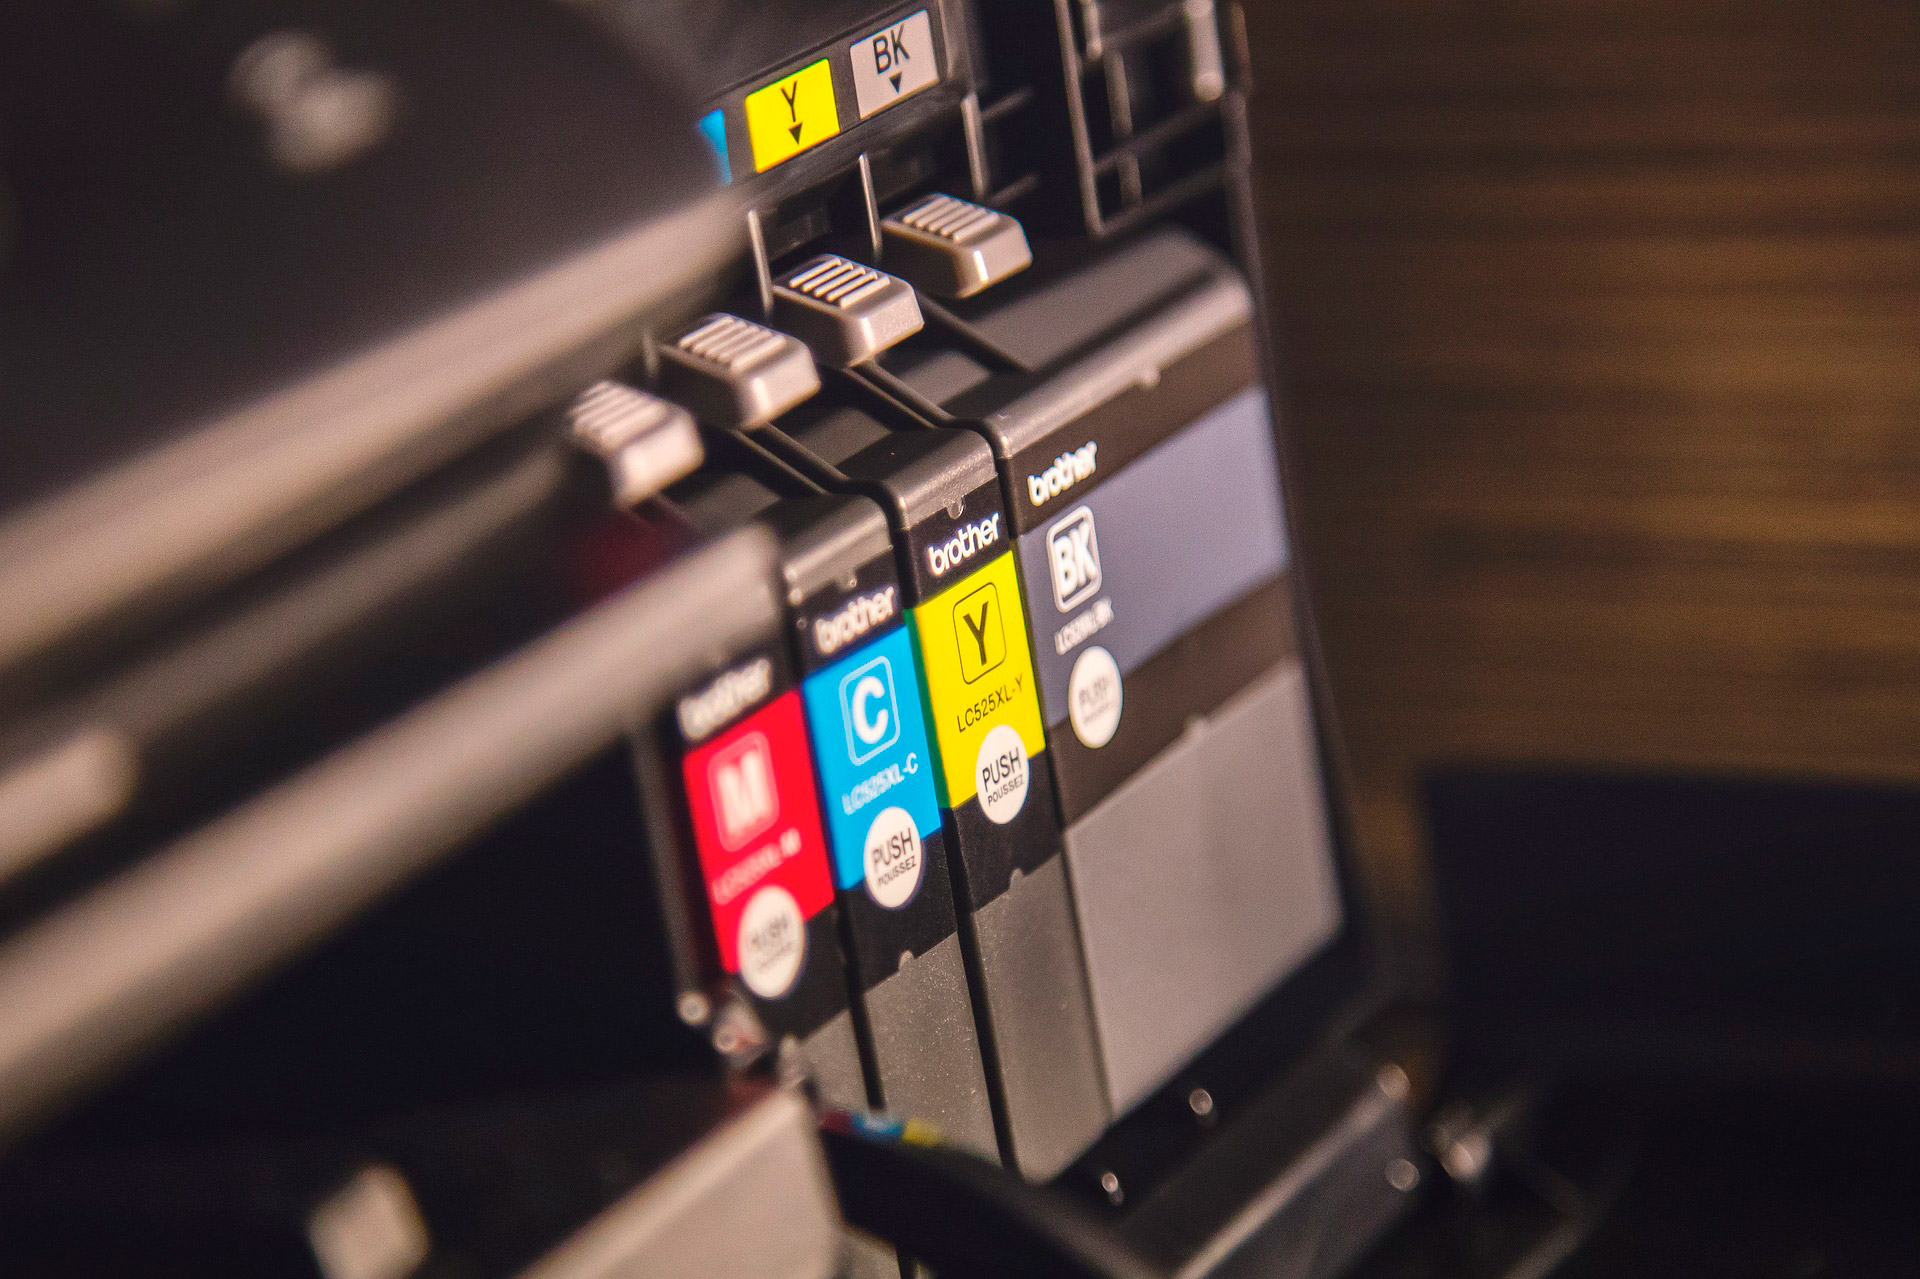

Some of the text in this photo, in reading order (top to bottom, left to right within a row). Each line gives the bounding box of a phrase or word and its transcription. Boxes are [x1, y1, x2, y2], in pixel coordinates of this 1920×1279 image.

[873, 24, 910, 75] BK
[780, 80, 798, 123] Y
[1027, 440, 1097, 506] brother
[928, 512, 999, 576] brother
[1054, 520, 1097, 597] BK
[815, 586, 894, 654] brother
[962, 600, 989, 666] Y
[851, 675, 888, 744] C
[957, 673, 1024, 733] LC525XL-Y
[716, 749, 773, 838] M
[982, 746, 1021, 792] PUSH
[988, 774, 1025, 806] POUSSEZ
[872, 827, 913, 876] PUSH
